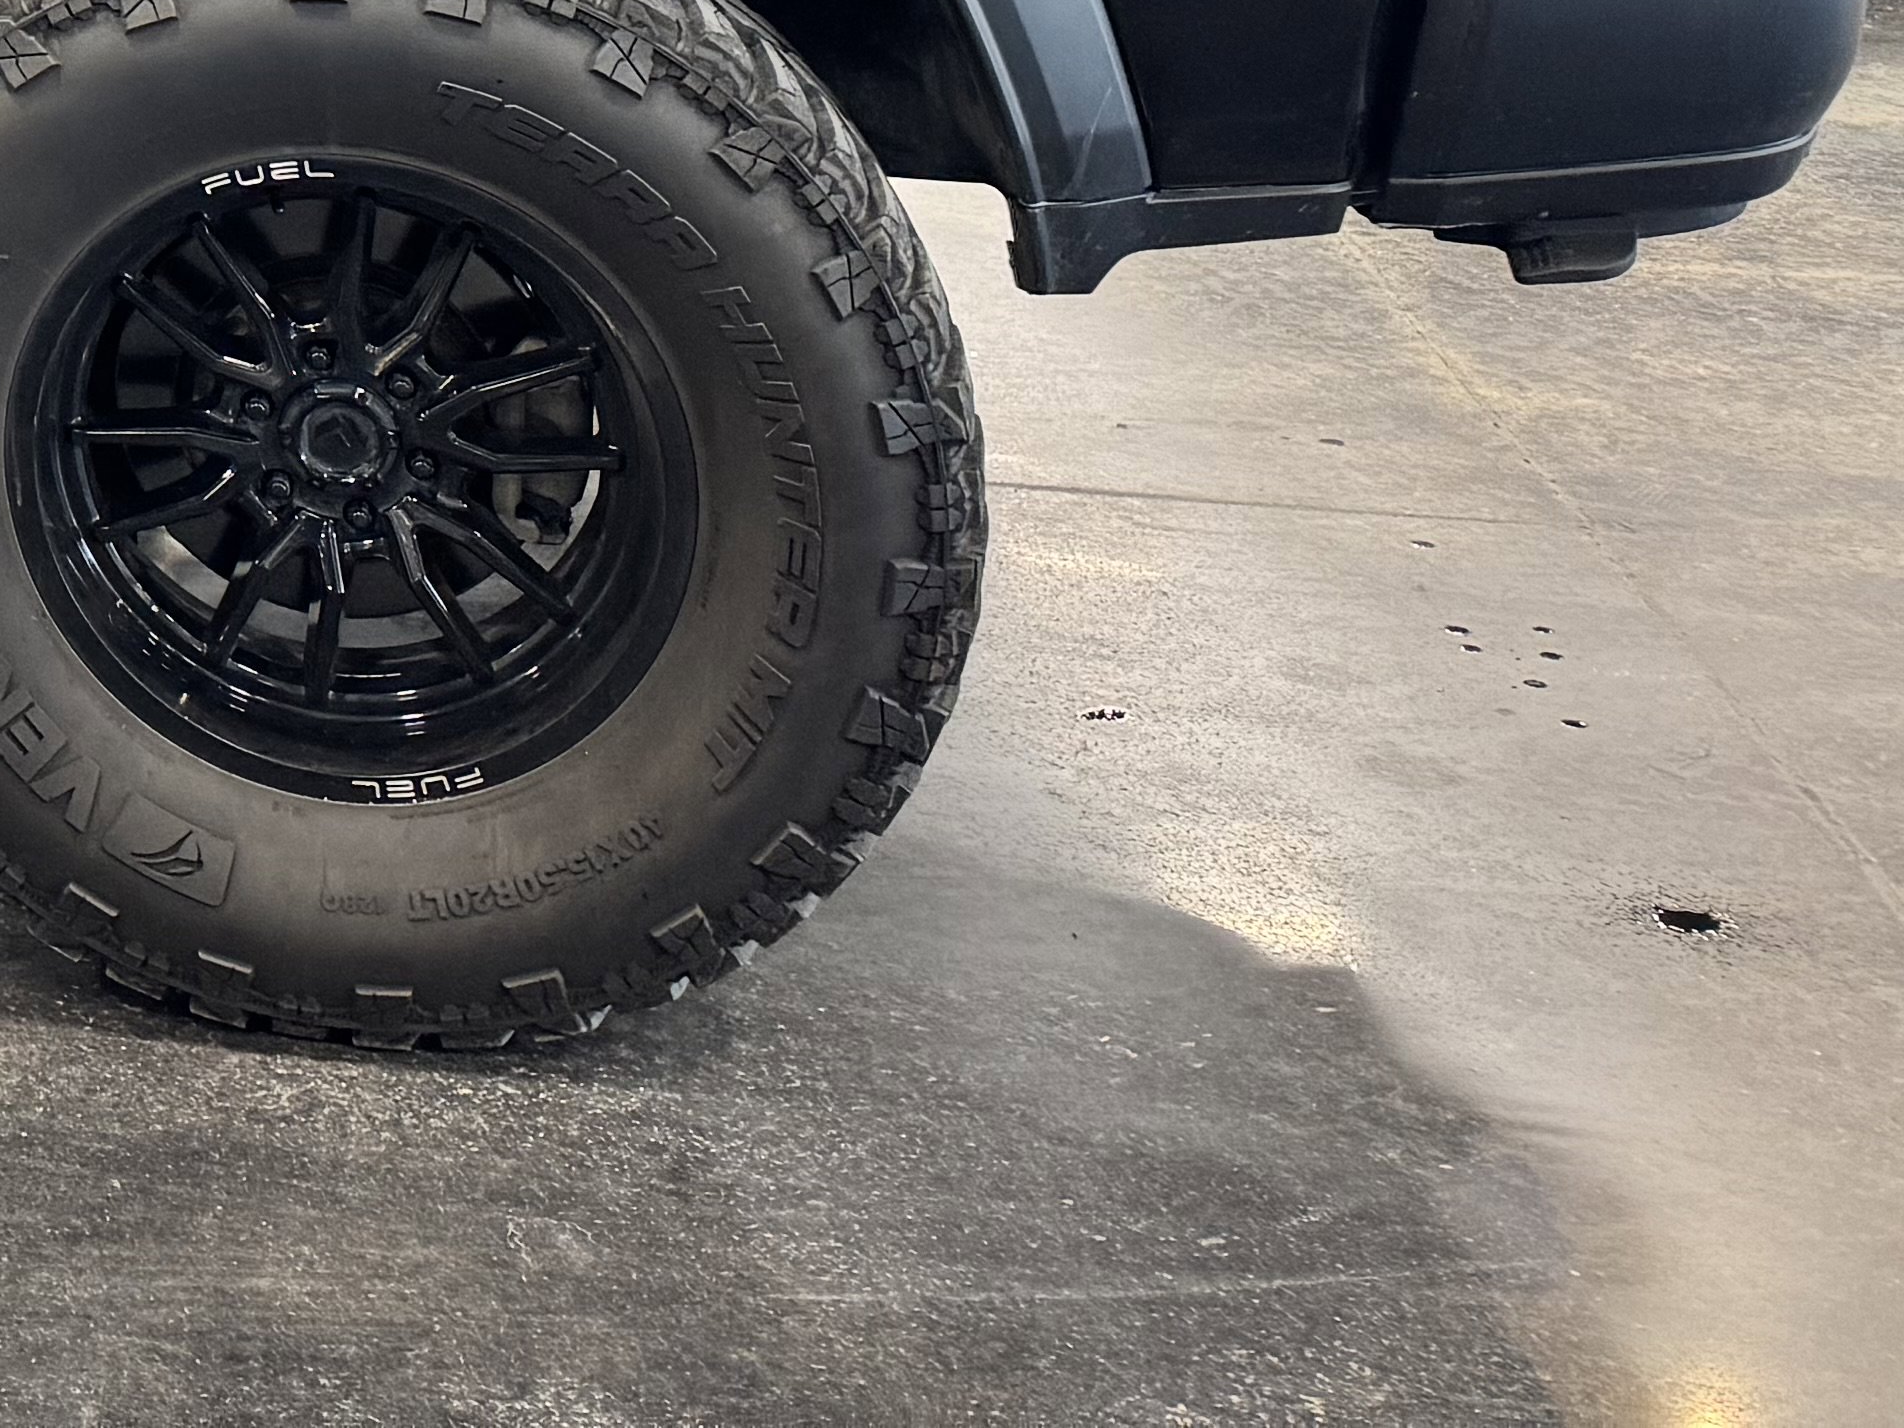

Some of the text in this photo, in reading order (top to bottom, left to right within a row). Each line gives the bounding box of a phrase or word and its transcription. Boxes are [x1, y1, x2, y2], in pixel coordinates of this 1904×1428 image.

[201, 160, 335, 195] FUEL
[434, 80, 720, 271] TERRA
[700, 284, 824, 651] HUNTER
[351, 766, 485, 799] FUEL
